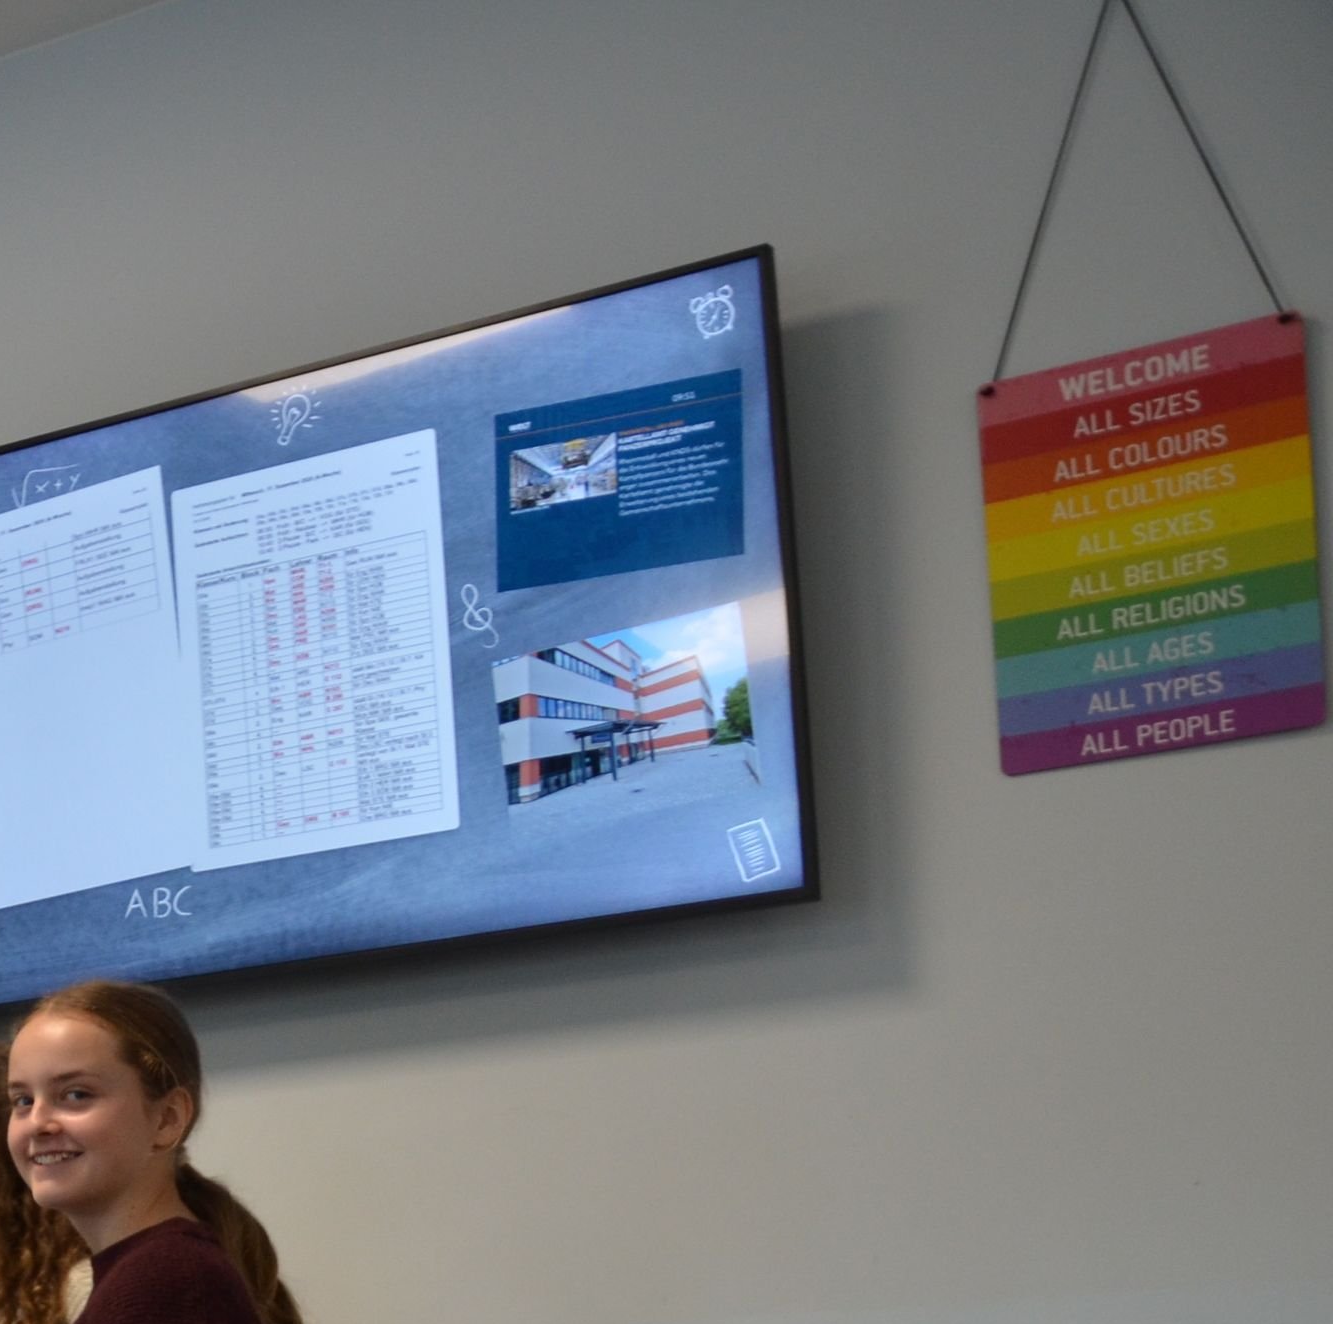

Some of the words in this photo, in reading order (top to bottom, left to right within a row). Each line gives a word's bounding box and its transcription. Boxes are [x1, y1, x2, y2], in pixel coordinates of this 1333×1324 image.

[1058, 344, 1210, 401] WELCOME
[1073, 412, 1121, 439] ALL
[1129, 389, 1201, 427] SIZES
[1053, 458, 1102, 484] ALL
[1108, 423, 1228, 471] COLOURS
[1051, 497, 1100, 524] ALL
[1105, 463, 1237, 511] CULTURES
[1077, 530, 1123, 558] ALL
[1132, 508, 1215, 545] SEXES
[1068, 573, 1112, 600] ALL
[1124, 546, 1228, 588] BELIEFS
[1056, 614, 1104, 642] ALL
[1112, 584, 1246, 629] RELIGIONS
[1091, 648, 1138, 675] ALL
[1146, 631, 1215, 665] AGES
[1087, 688, 1135, 716] ALL
[1142, 671, 1224, 703] TYPES
[1081, 729, 1129, 757] ALL
[1137, 709, 1236, 747] PEOPLE
[124, 884, 193, 919] ABC
